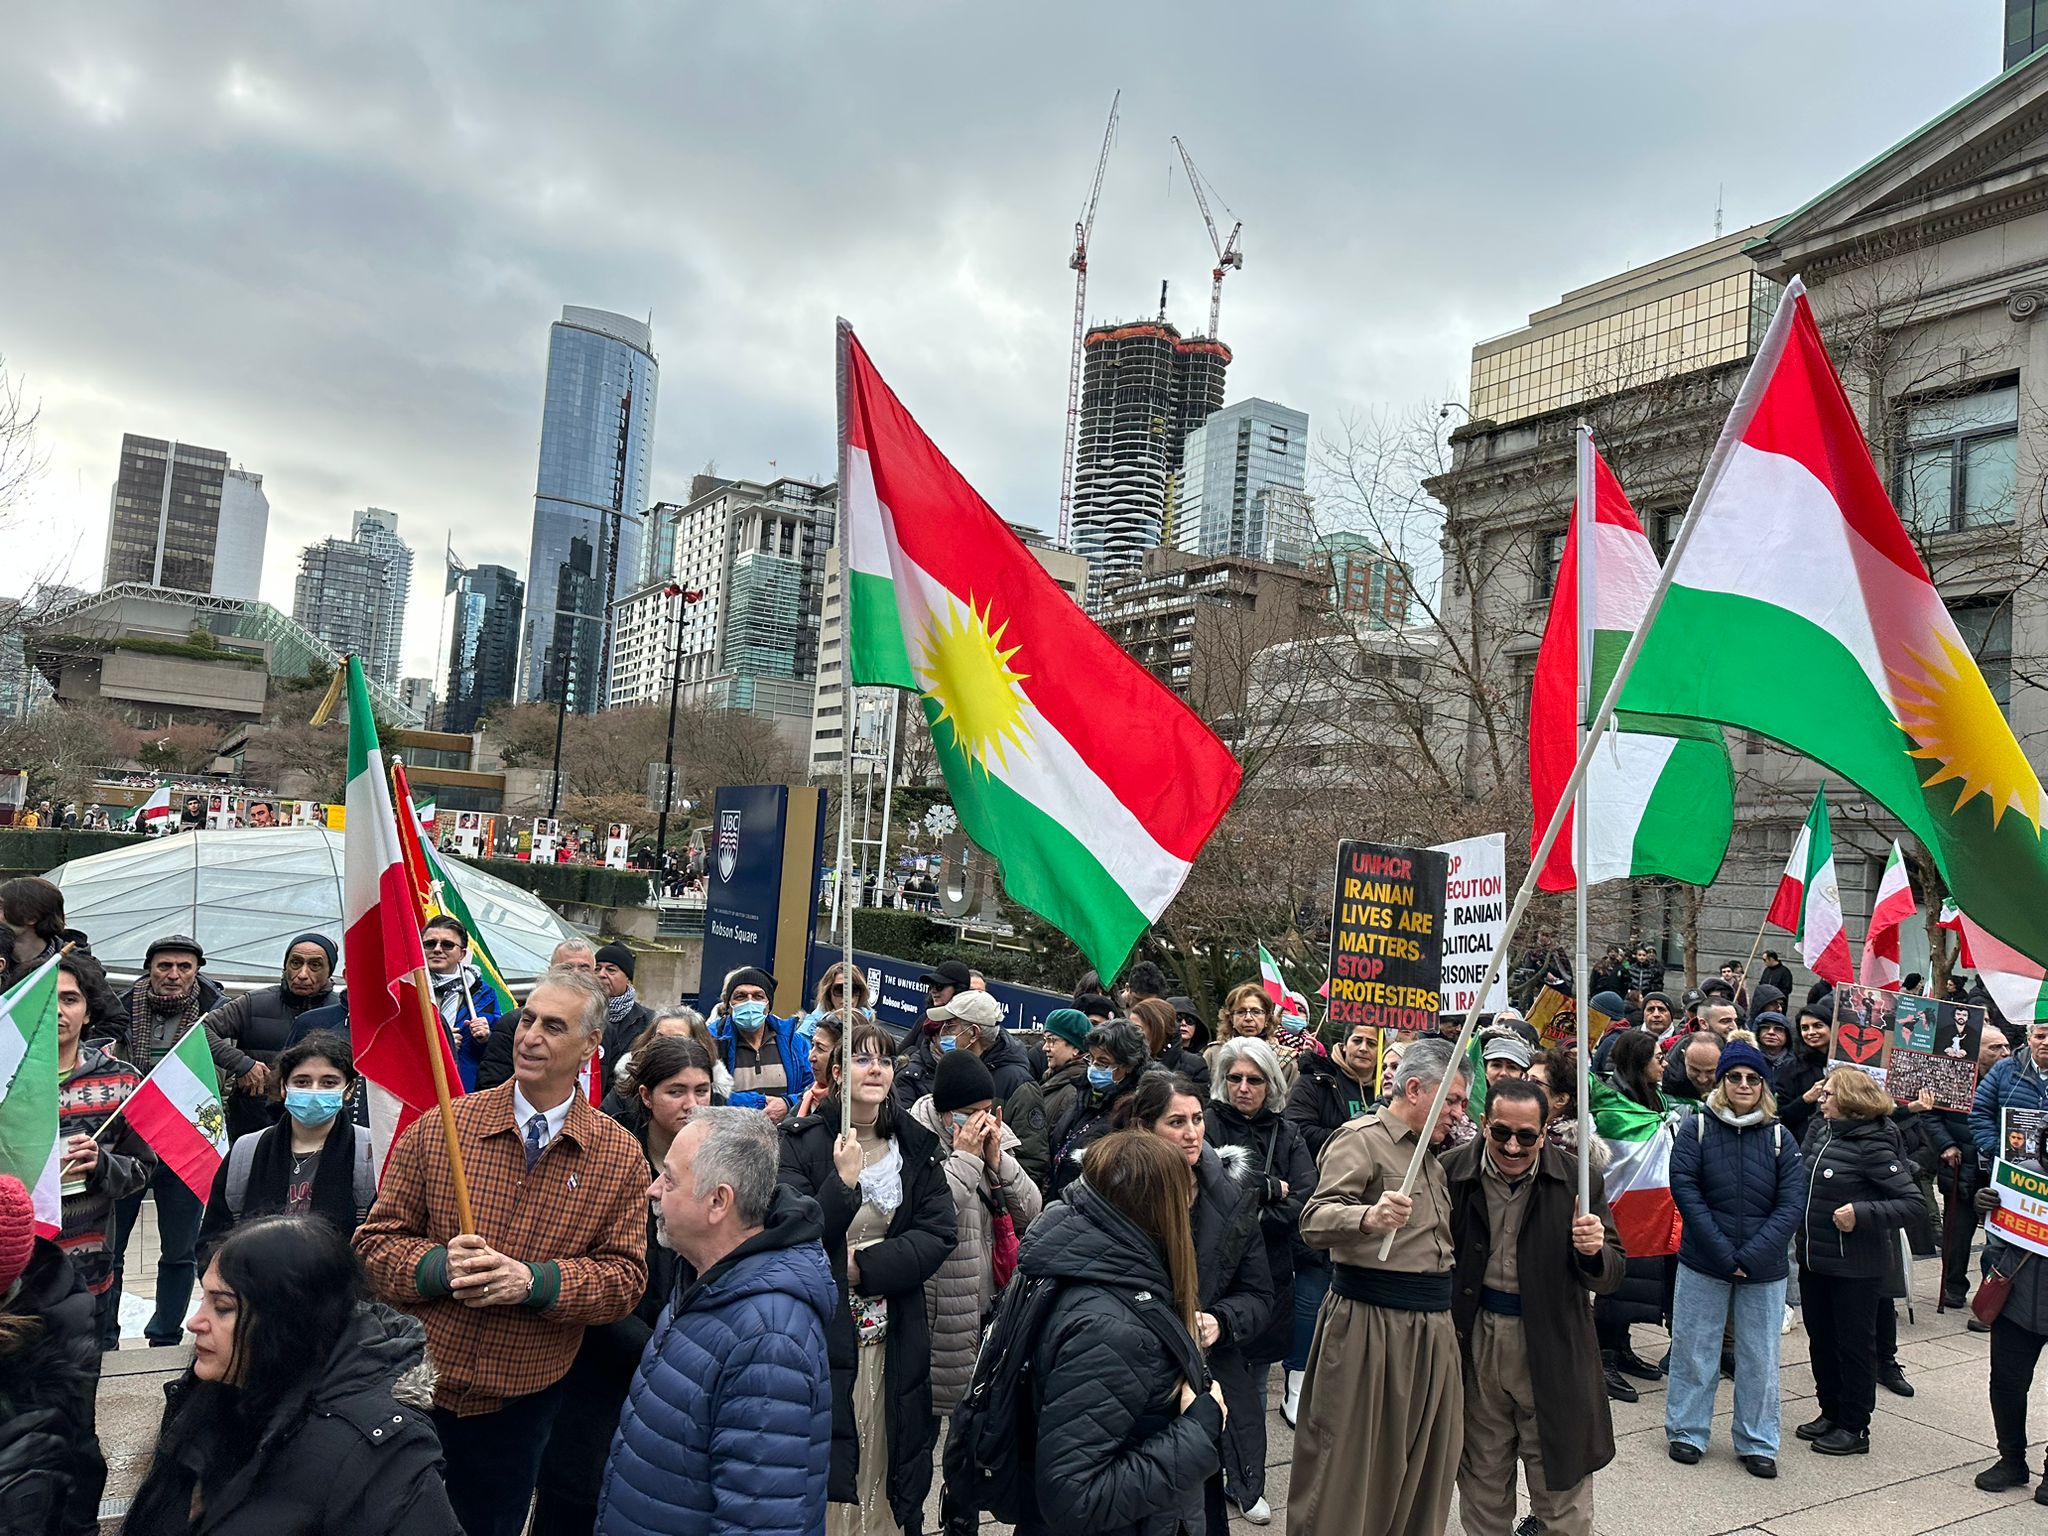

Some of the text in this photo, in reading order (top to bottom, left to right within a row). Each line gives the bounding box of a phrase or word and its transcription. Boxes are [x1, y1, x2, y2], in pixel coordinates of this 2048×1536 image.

[722, 814, 739, 831] UBC
[1352, 852, 1412, 880] UNHCR
[1447, 855, 1462, 877] OP
[1344, 877, 1414, 907] IRANIAN
[1447, 875, 1502, 900] ECUTION
[1342, 903, 1393, 929] LIVES
[1398, 909, 1433, 935] ARE
[1454, 901, 1502, 926] IRANIAN
[711, 920, 758, 945] Robson Square
[1442, 933, 1494, 957] OLITICAL
[1337, 954, 1384, 980] STOP
[884, 974, 930, 994] THE UNIVERSIT
[1331, 978, 1440, 1012] PROTESTERS
[882, 994, 918, 1014] Robson Square
[1455, 990, 1484, 1011] IRA
[2010, 1171, 2048, 1196] WOM
[2020, 1198, 2048, 1217] LIF
[1996, 1209, 2048, 1241] FREED
